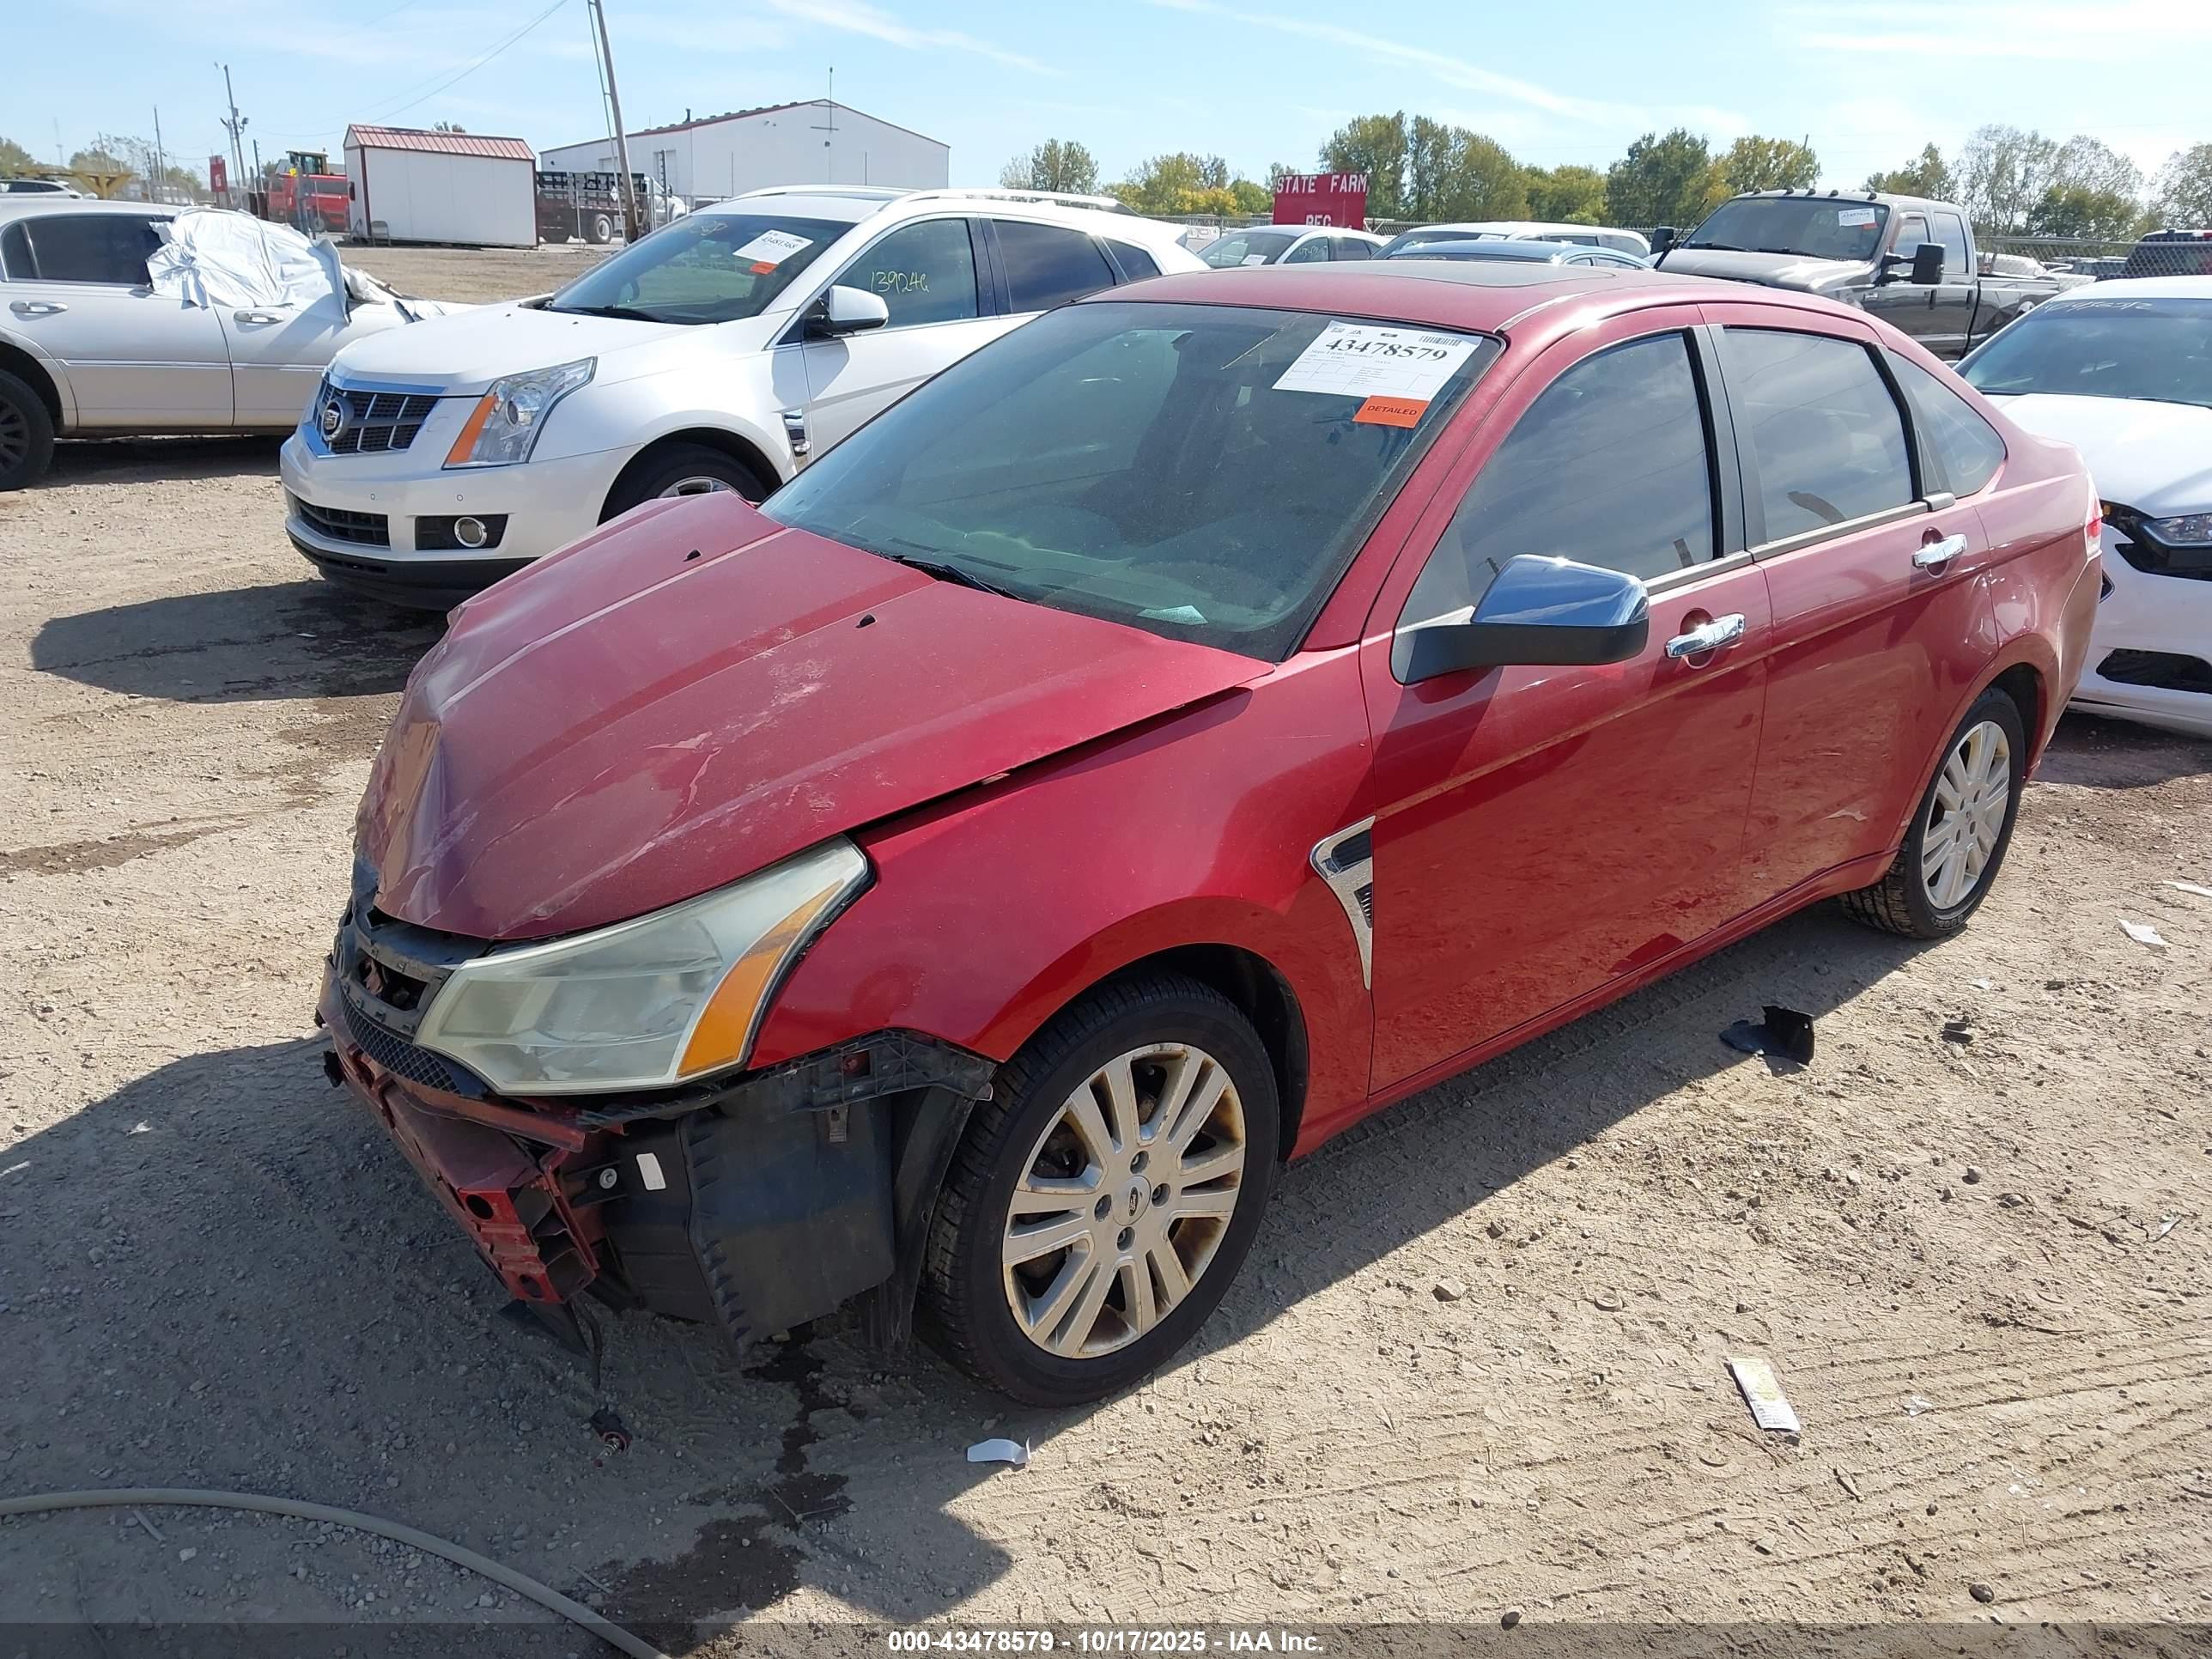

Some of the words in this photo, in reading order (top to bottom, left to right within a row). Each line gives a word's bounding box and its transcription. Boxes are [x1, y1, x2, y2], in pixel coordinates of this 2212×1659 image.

[1277, 175, 1317, 193] STATE
[1330, 173, 1368, 193] FARM
[1326, 338, 1447, 362] 43478579
[1367, 405, 1417, 416] DETAILED
